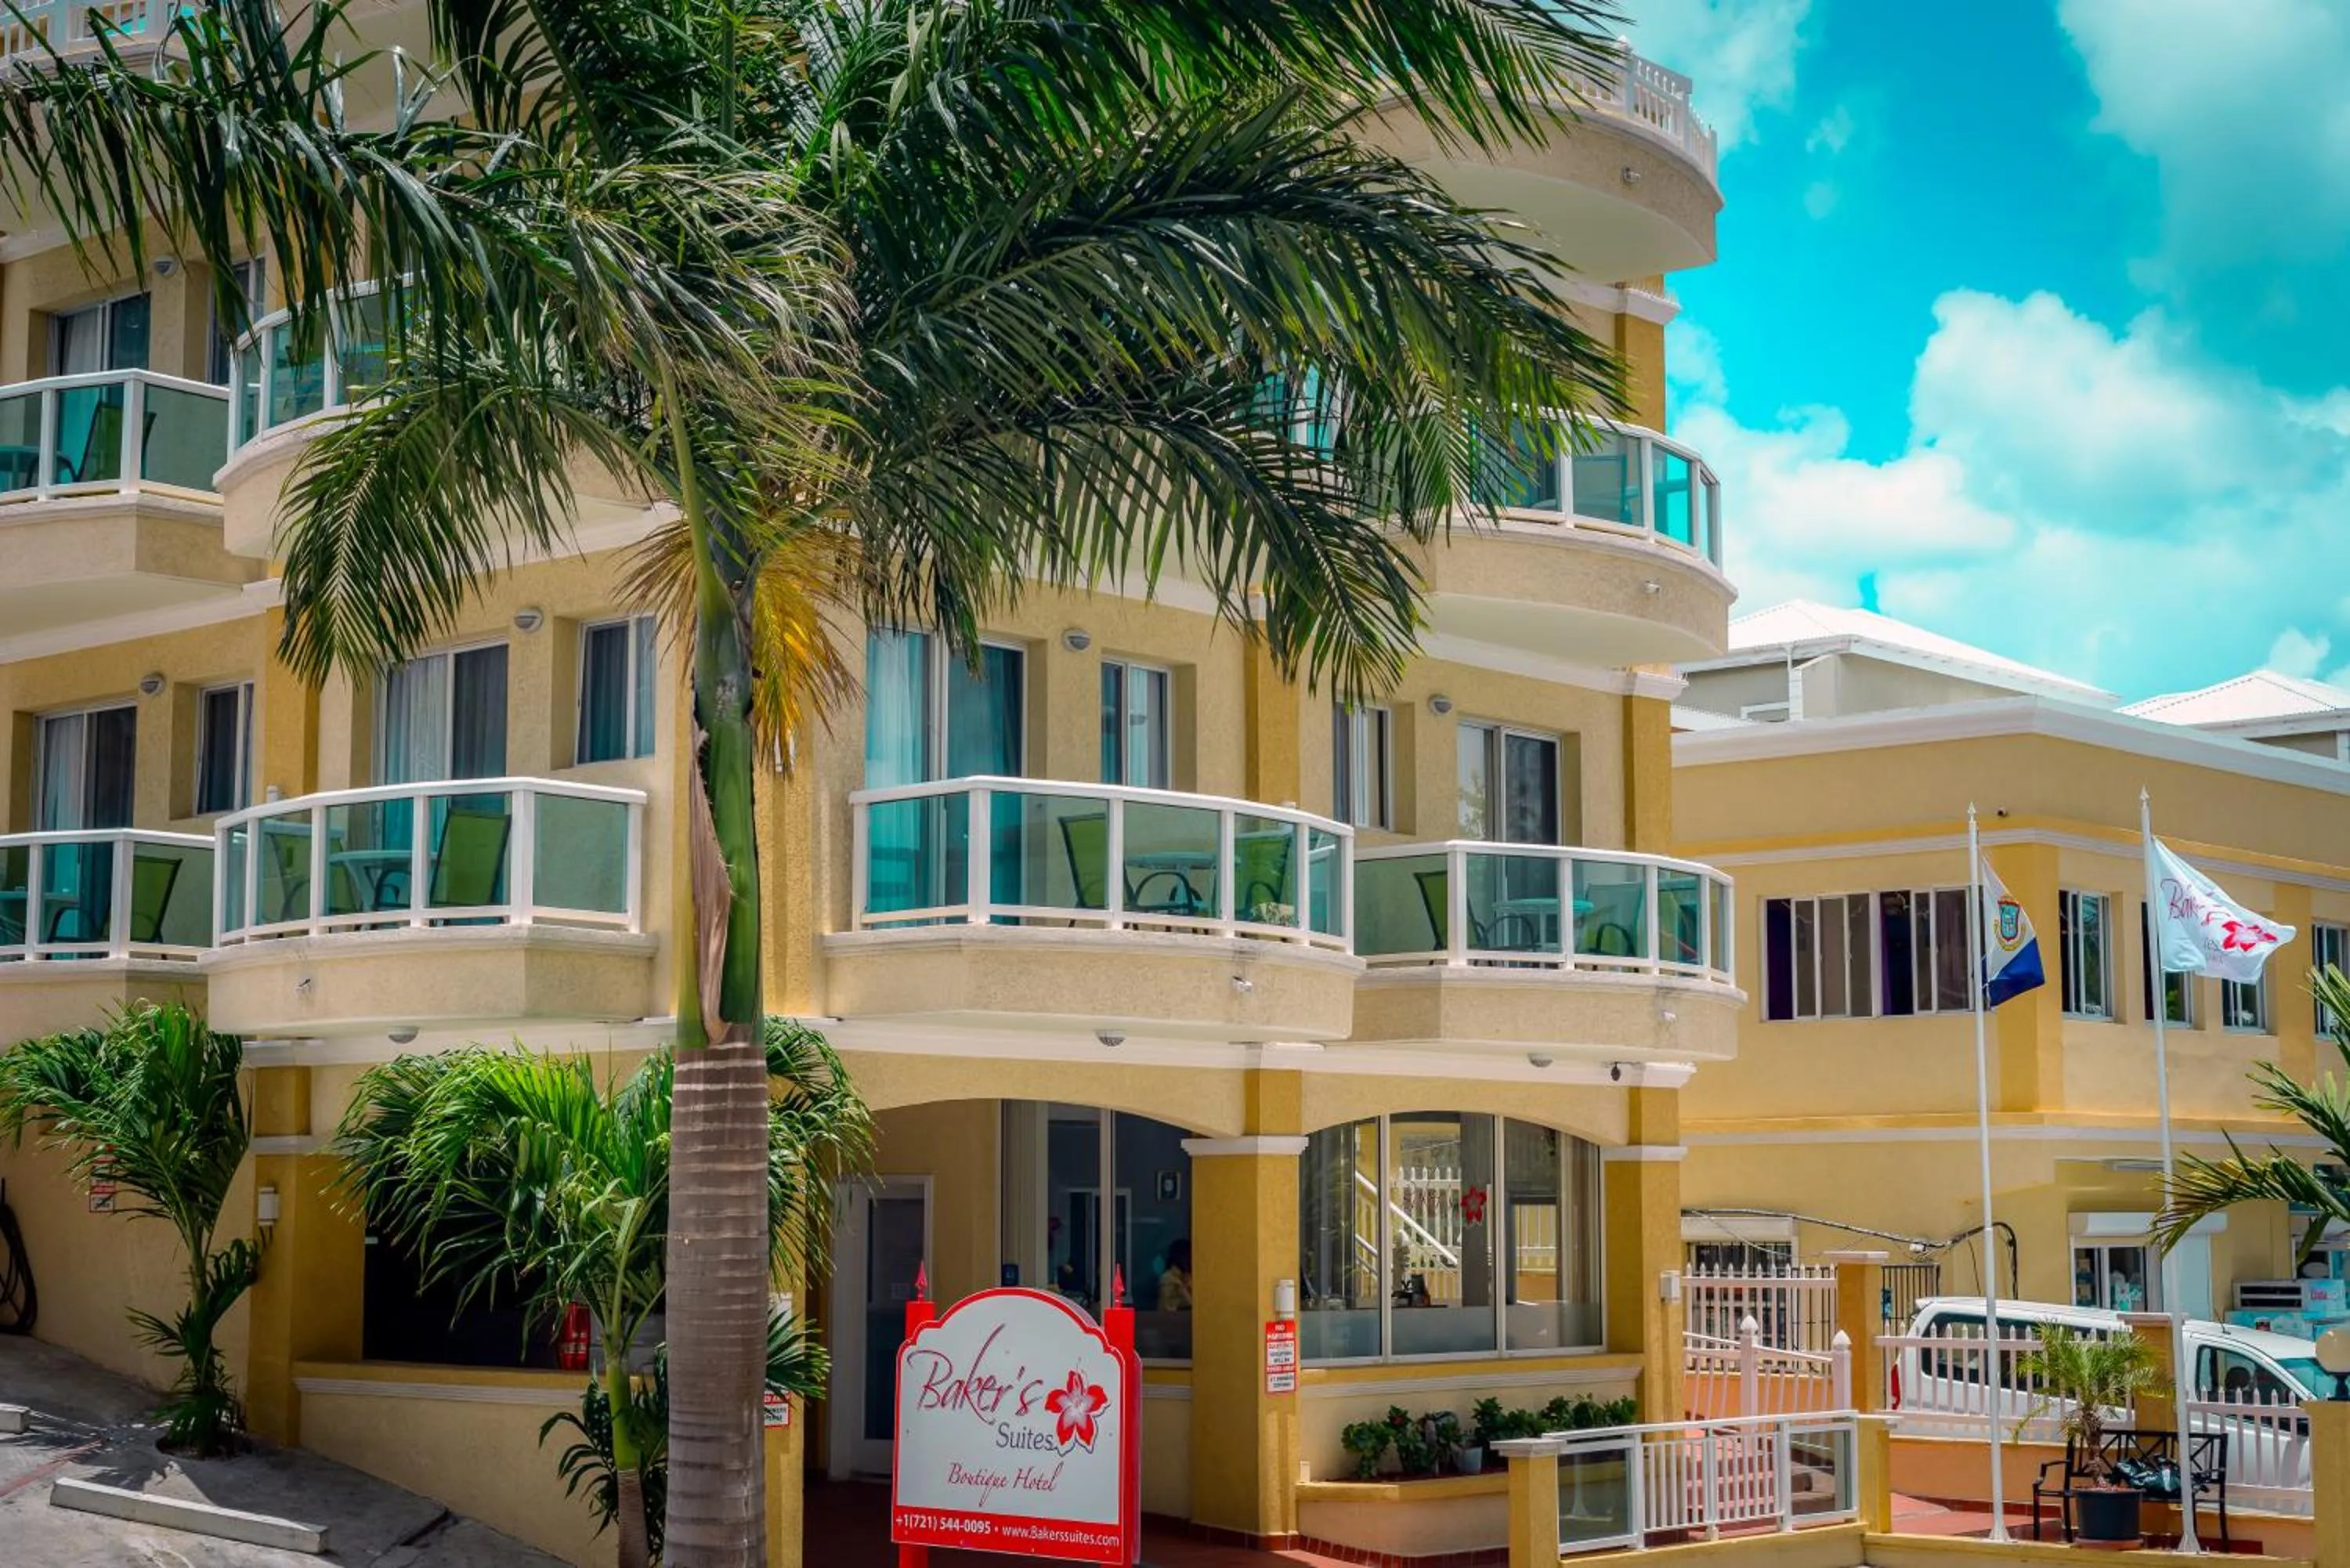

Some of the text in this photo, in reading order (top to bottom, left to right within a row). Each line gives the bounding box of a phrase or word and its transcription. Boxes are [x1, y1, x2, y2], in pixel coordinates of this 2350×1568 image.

[907, 1323, 1043, 1425] Baker's
[996, 1422, 1054, 1451] Suites
[948, 1461, 1064, 1507] Boutique Hotel
[895, 1513, 1119, 1547] +1(721) 544-0095 www.Bakerssuites.com
